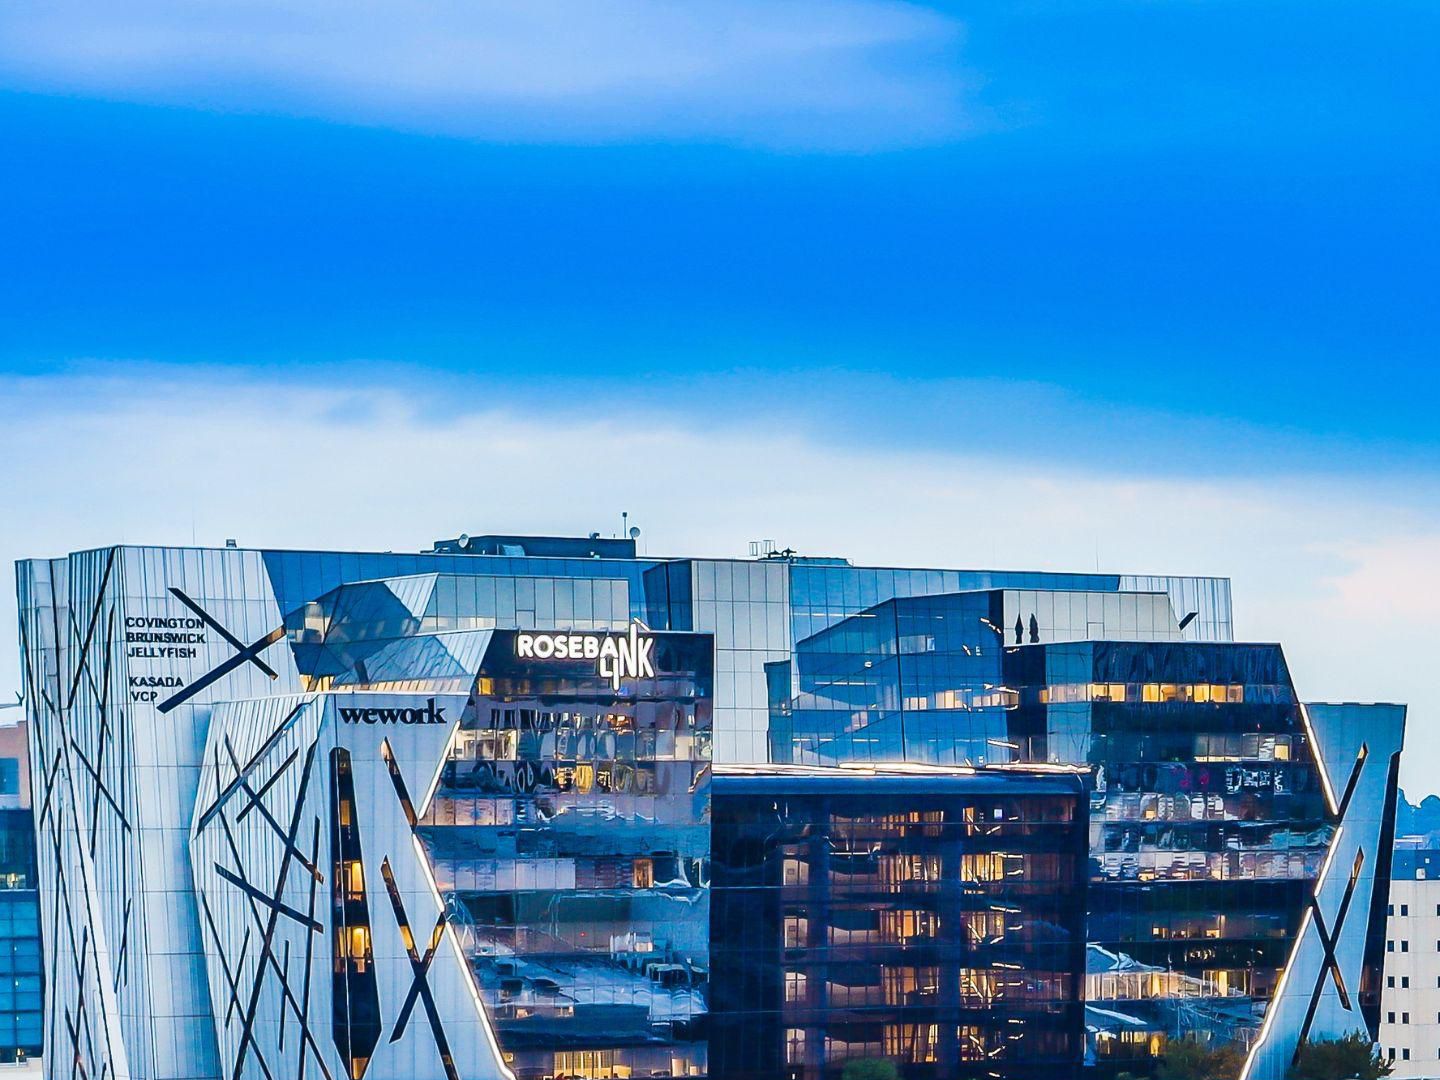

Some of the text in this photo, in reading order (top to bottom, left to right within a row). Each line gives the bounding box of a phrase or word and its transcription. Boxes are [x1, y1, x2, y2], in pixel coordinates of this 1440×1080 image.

[126, 617, 205, 628] COVINGTON
[126, 632, 206, 643] BRUNSWICK
[128, 647, 196, 658] JELLYFISH
[129, 676, 183, 687] KASADA
[131, 691, 158, 701] VCP
[338, 698, 447, 724] wework
